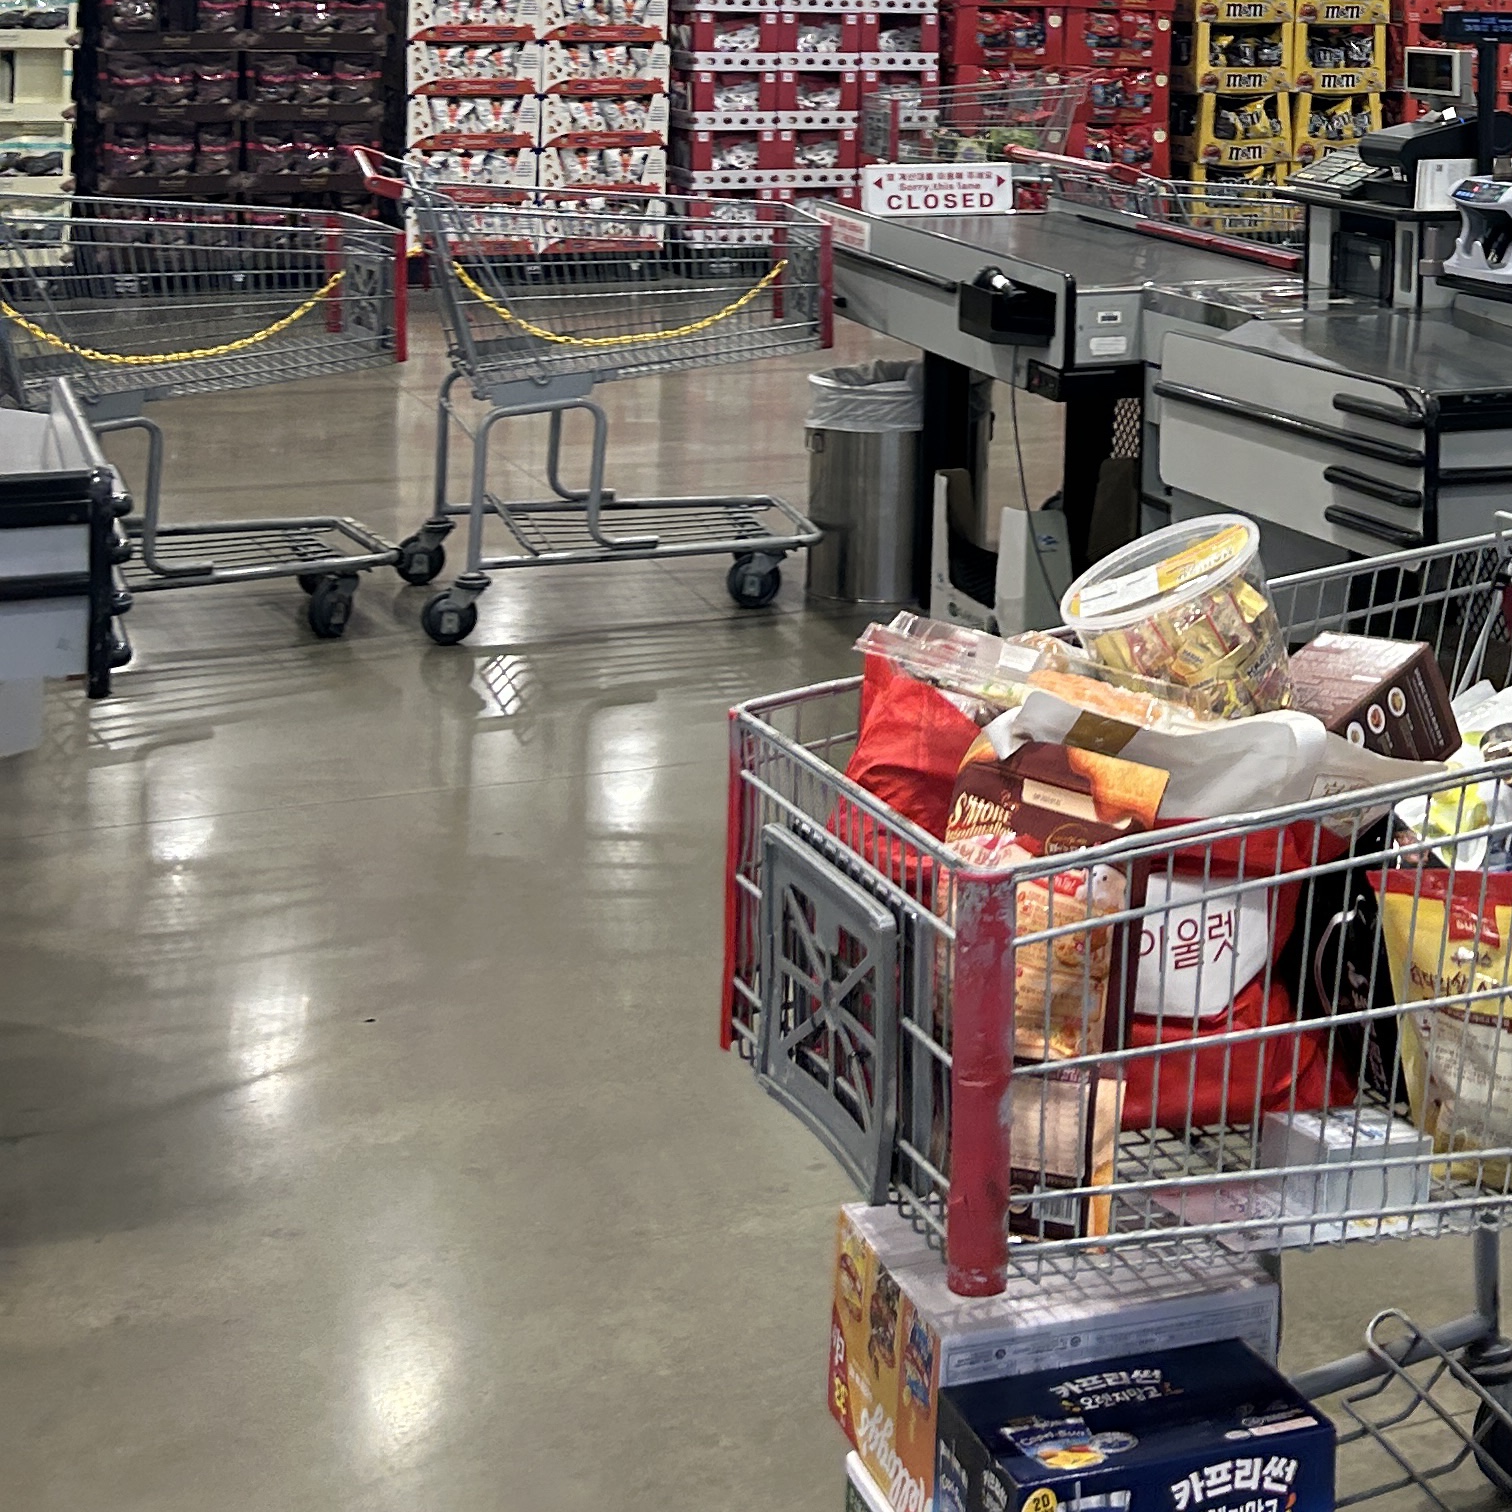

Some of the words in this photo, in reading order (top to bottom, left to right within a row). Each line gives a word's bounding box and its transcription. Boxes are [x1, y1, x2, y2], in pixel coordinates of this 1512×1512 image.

[957, 182, 981, 190] lane
[887, 193, 994, 210] CLOSED
[1049, 1368, 1162, 1399] 카프리썬
[1080, 1385, 1162, 1410] 오렌지망고
[1170, 1455, 1298, 1512] 카프리썬
[1033, 1493, 1051, 1512] 20
